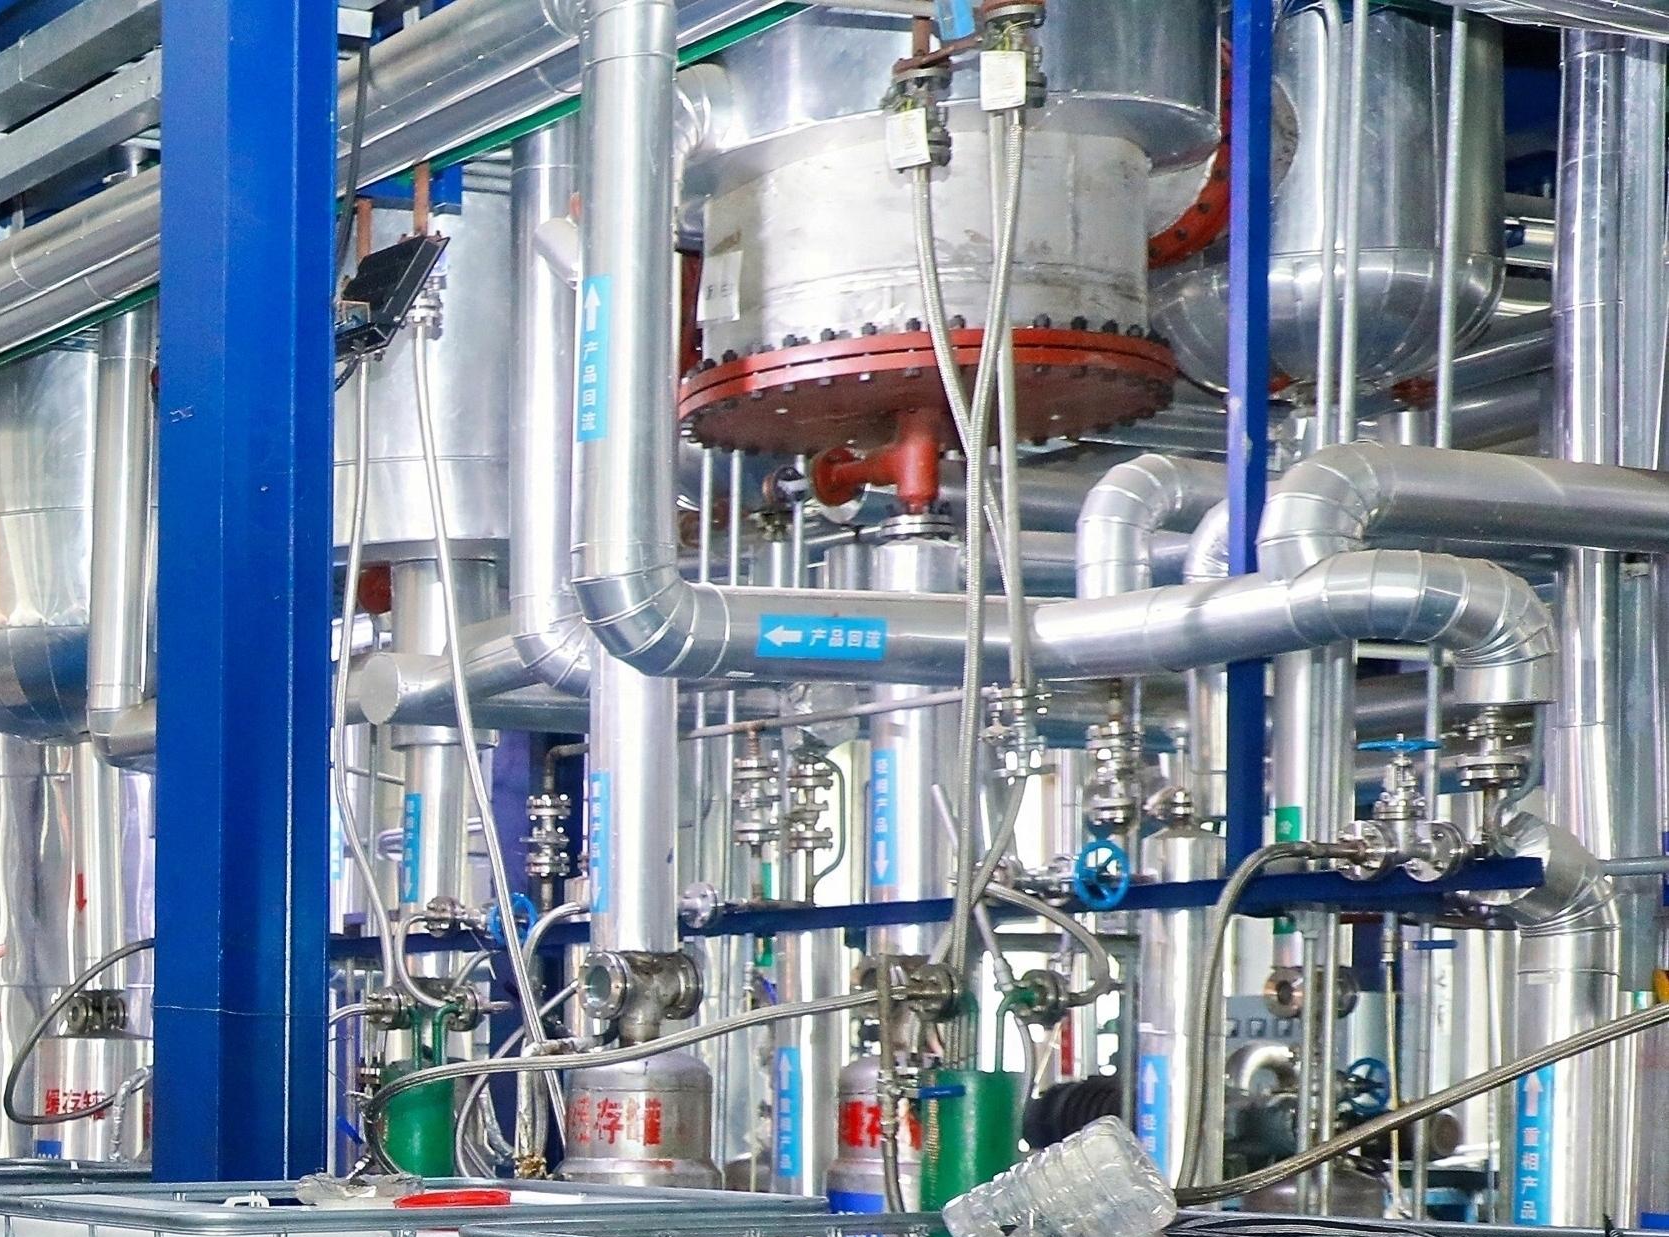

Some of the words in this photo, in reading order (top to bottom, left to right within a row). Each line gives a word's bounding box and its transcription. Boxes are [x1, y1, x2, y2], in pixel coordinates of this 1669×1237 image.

[808, 627, 882, 649] 产品回流
[1521, 1127, 1541, 1220] 重相产品
